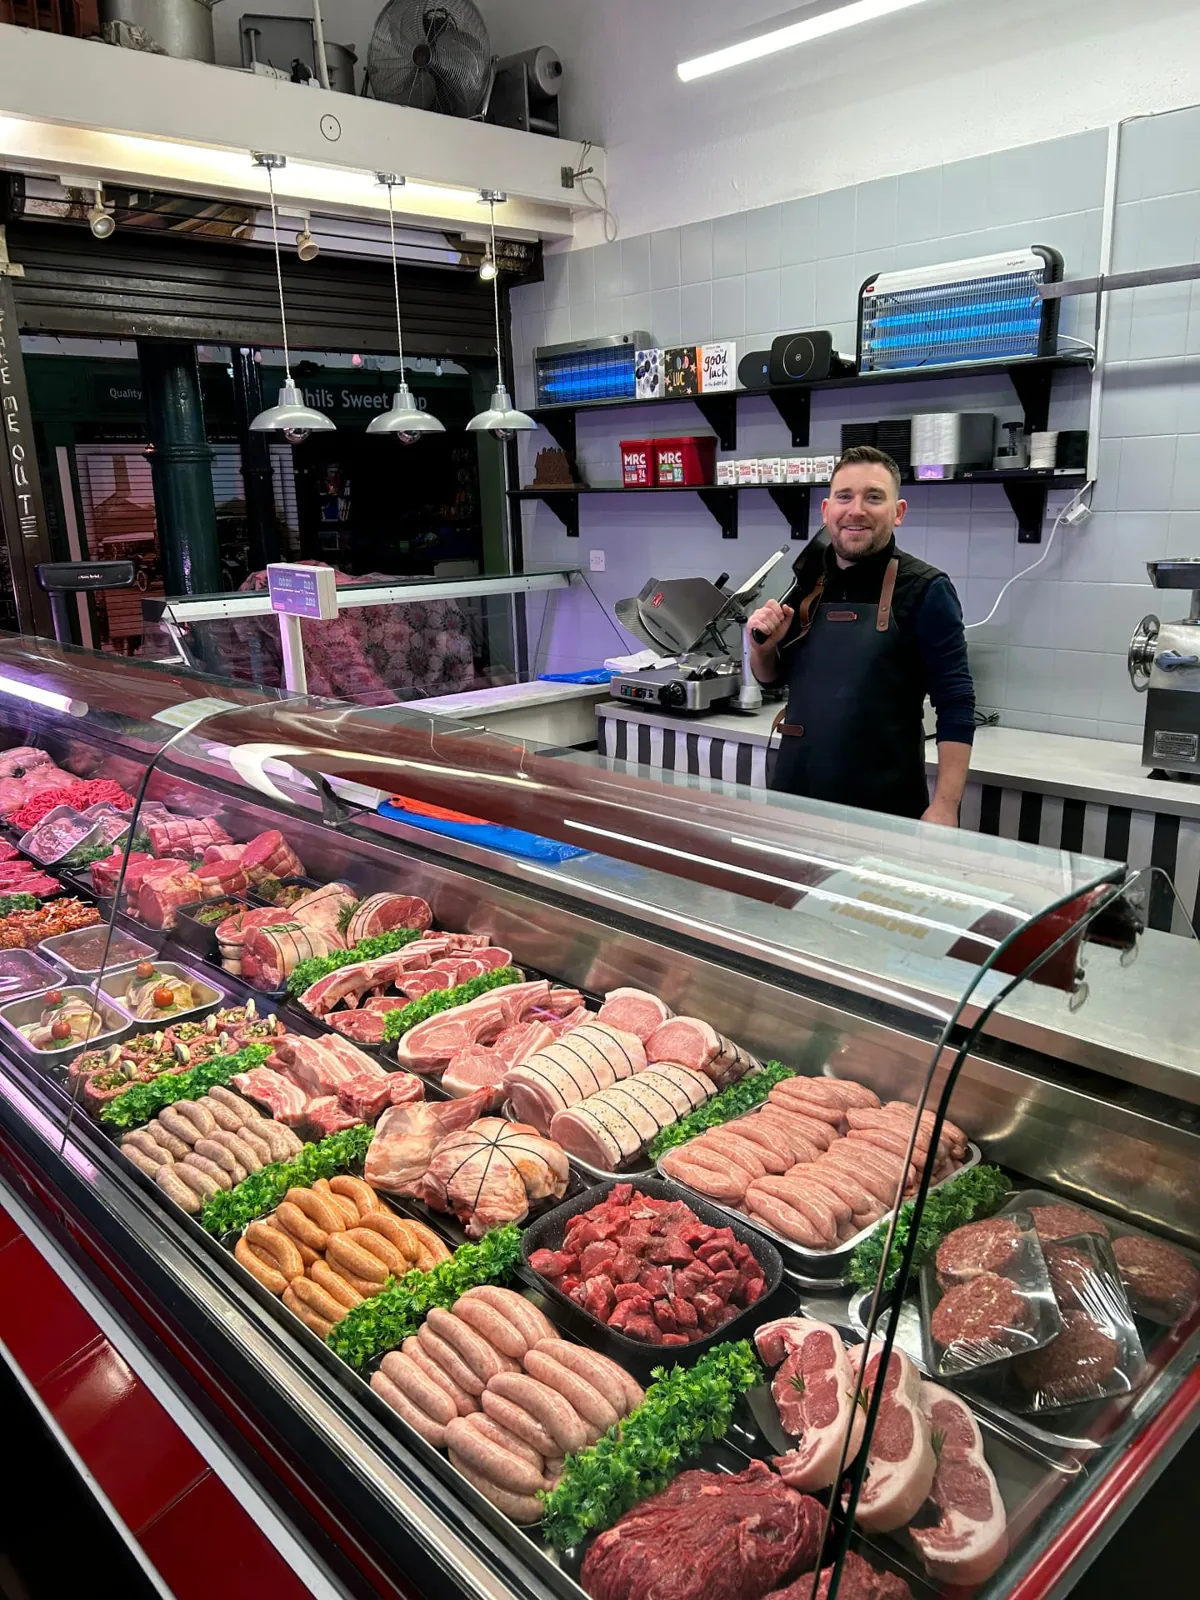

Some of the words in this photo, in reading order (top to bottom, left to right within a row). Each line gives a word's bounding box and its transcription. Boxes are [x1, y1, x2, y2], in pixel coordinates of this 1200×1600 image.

[703, 350, 727, 372] good
[708, 365, 728, 380] luck
[109, 388, 142, 400] Quality
[302, 388, 334, 408] hil's
[341, 389, 390, 409] Sweet
[624, 453, 646, 465] MRC
[659, 452, 682, 464] MRC
